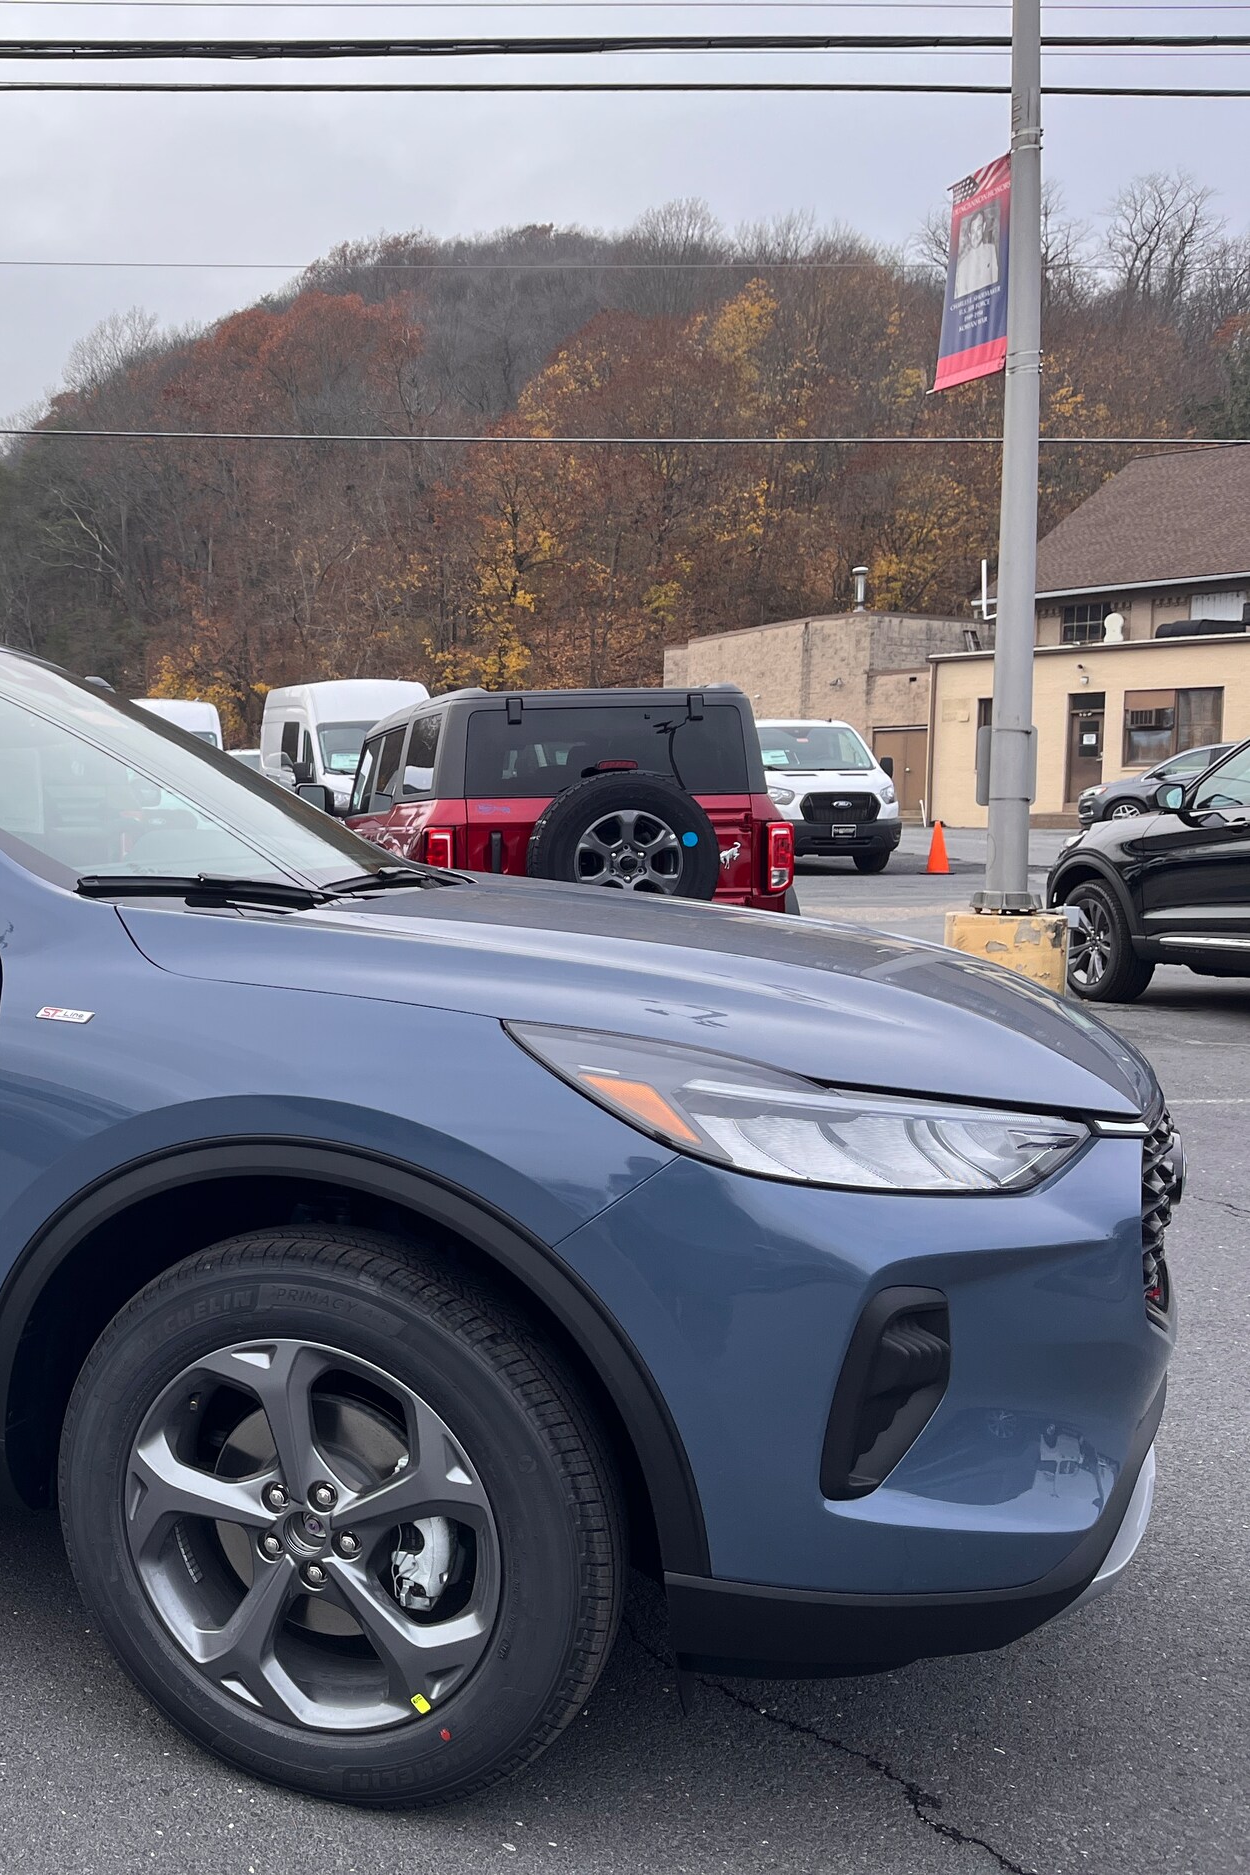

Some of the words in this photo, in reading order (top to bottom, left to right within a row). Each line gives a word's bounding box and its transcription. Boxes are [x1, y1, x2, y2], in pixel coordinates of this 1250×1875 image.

[41, 1007, 63, 1018] ST
[139, 1289, 254, 1351] MICHELIN
[276, 1288, 359, 1313] PRIMACY
